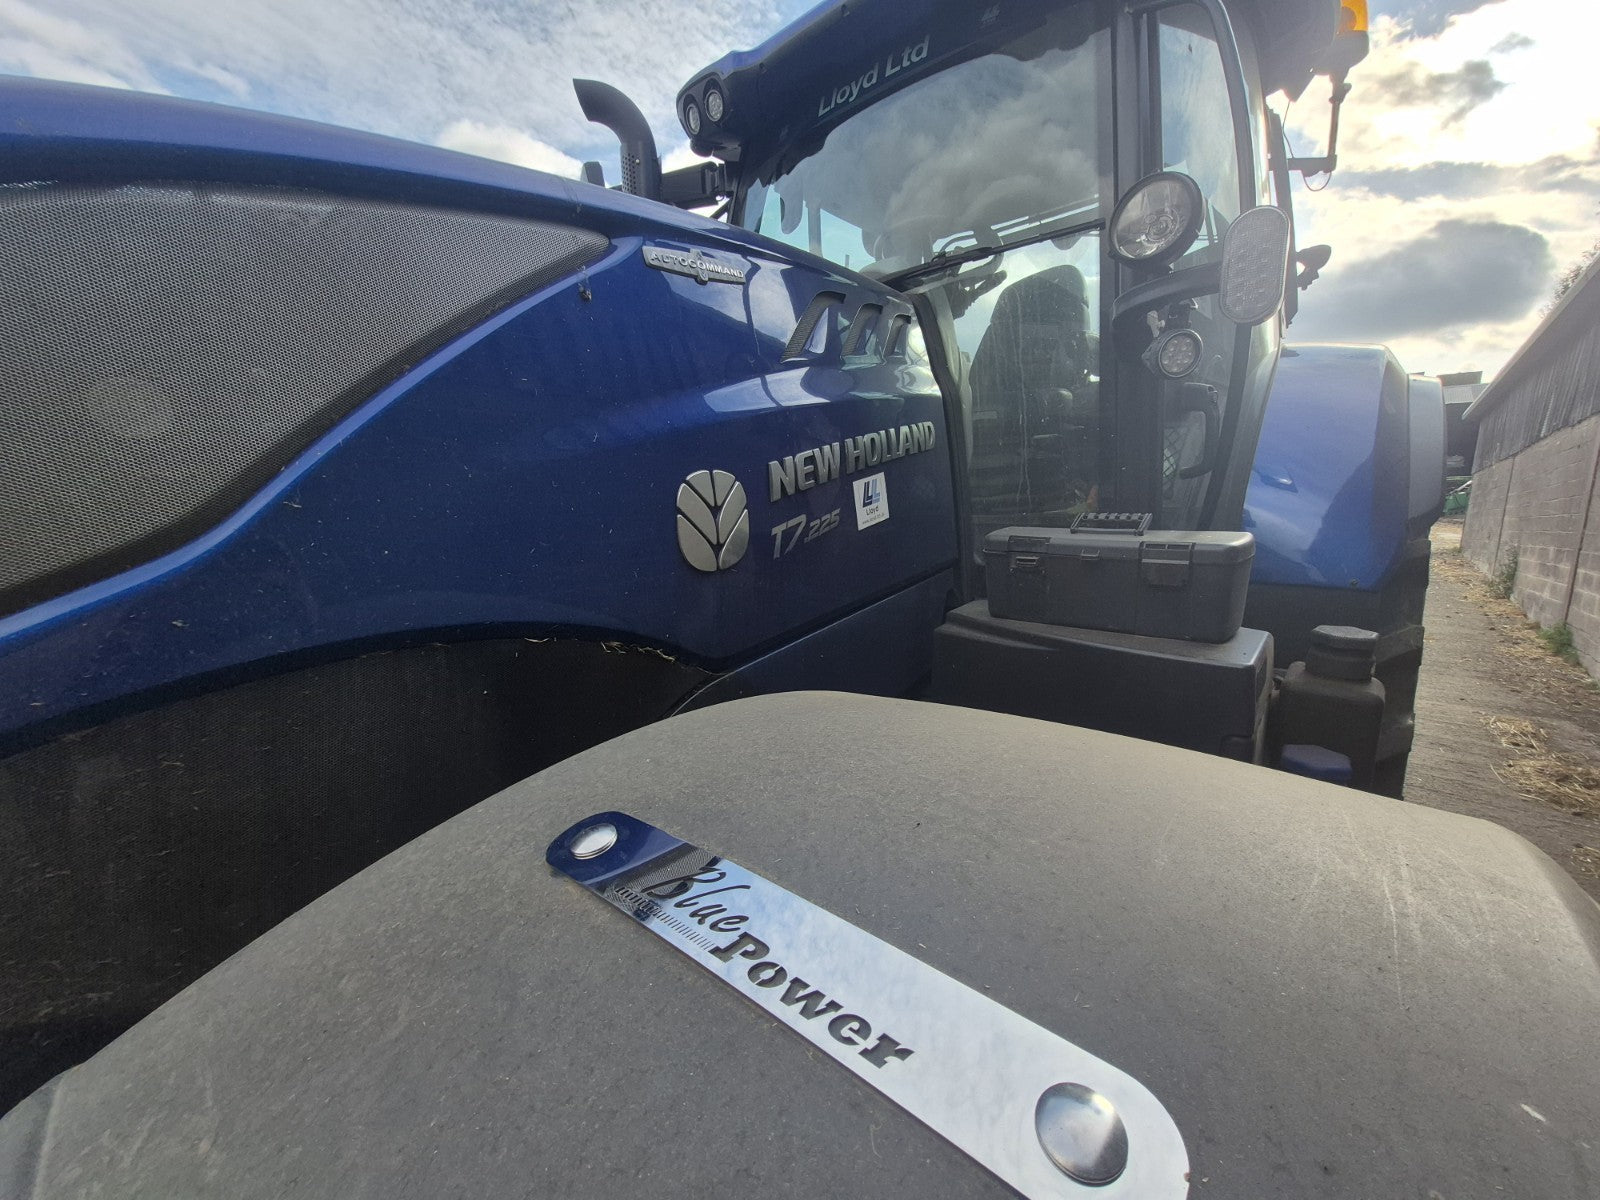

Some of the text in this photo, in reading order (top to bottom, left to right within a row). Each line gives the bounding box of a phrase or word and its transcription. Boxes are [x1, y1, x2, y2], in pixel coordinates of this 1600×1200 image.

[818, 34, 930, 118] Lloyd Ltd
[650, 250, 745, 278] AUTOCOMMAND
[768, 421, 936, 503] NEW HOLLAND
[641, 866, 915, 1069] Blue Power
